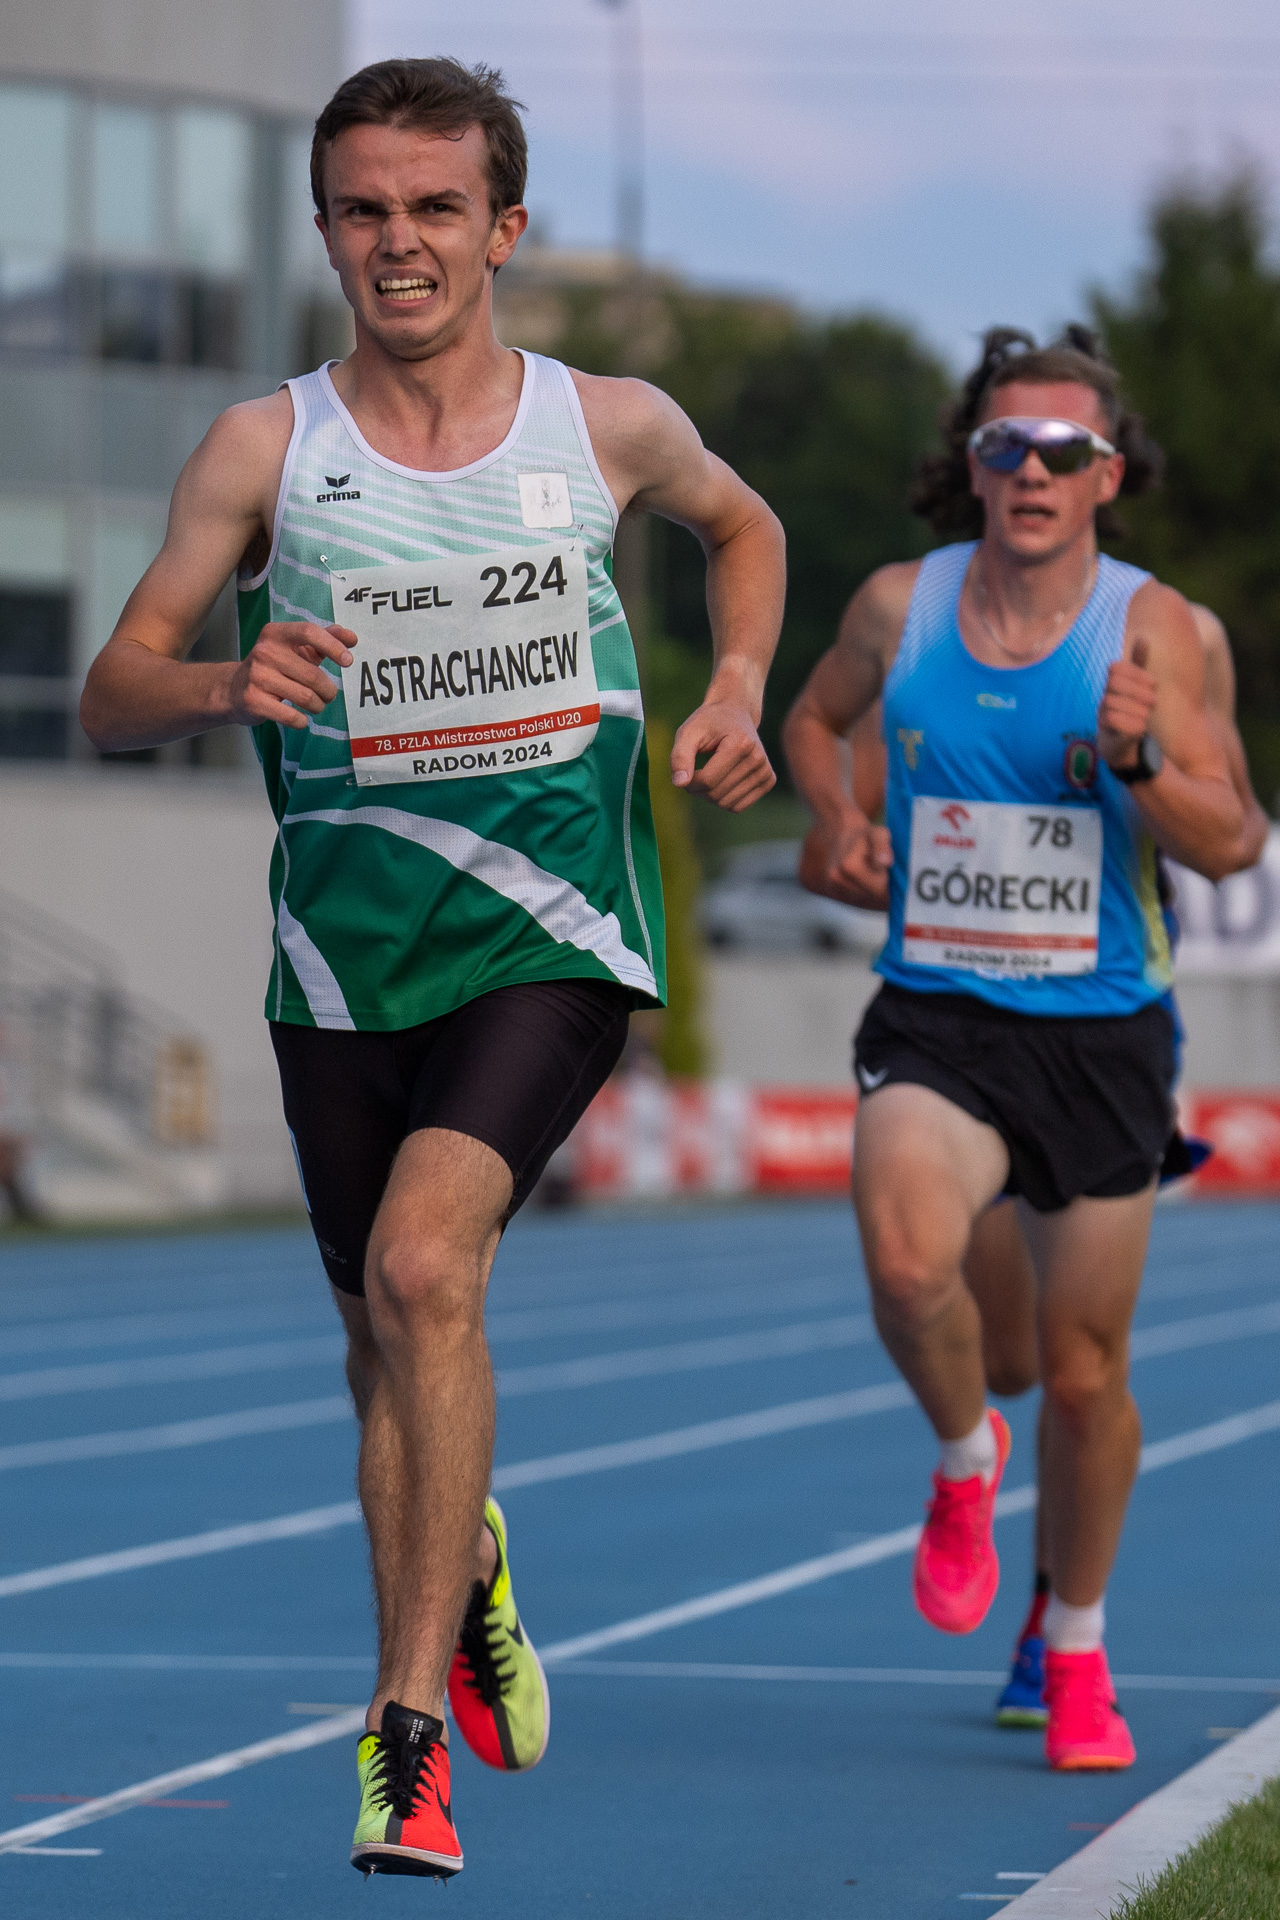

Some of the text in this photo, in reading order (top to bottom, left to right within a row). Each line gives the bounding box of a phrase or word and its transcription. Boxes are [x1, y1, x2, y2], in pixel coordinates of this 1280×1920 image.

[316, 489, 361, 503] erima
[479, 555, 568, 609] 224
[359, 631, 578, 708] ASTRACHANCEW
[375, 711, 582, 752] 78. PZLA Mistrzostwa Polski U20
[412, 741, 553, 776] RADOM 2024
[1028, 814, 1074, 848] 78
[915, 862, 1090, 913] GÓRECKI
